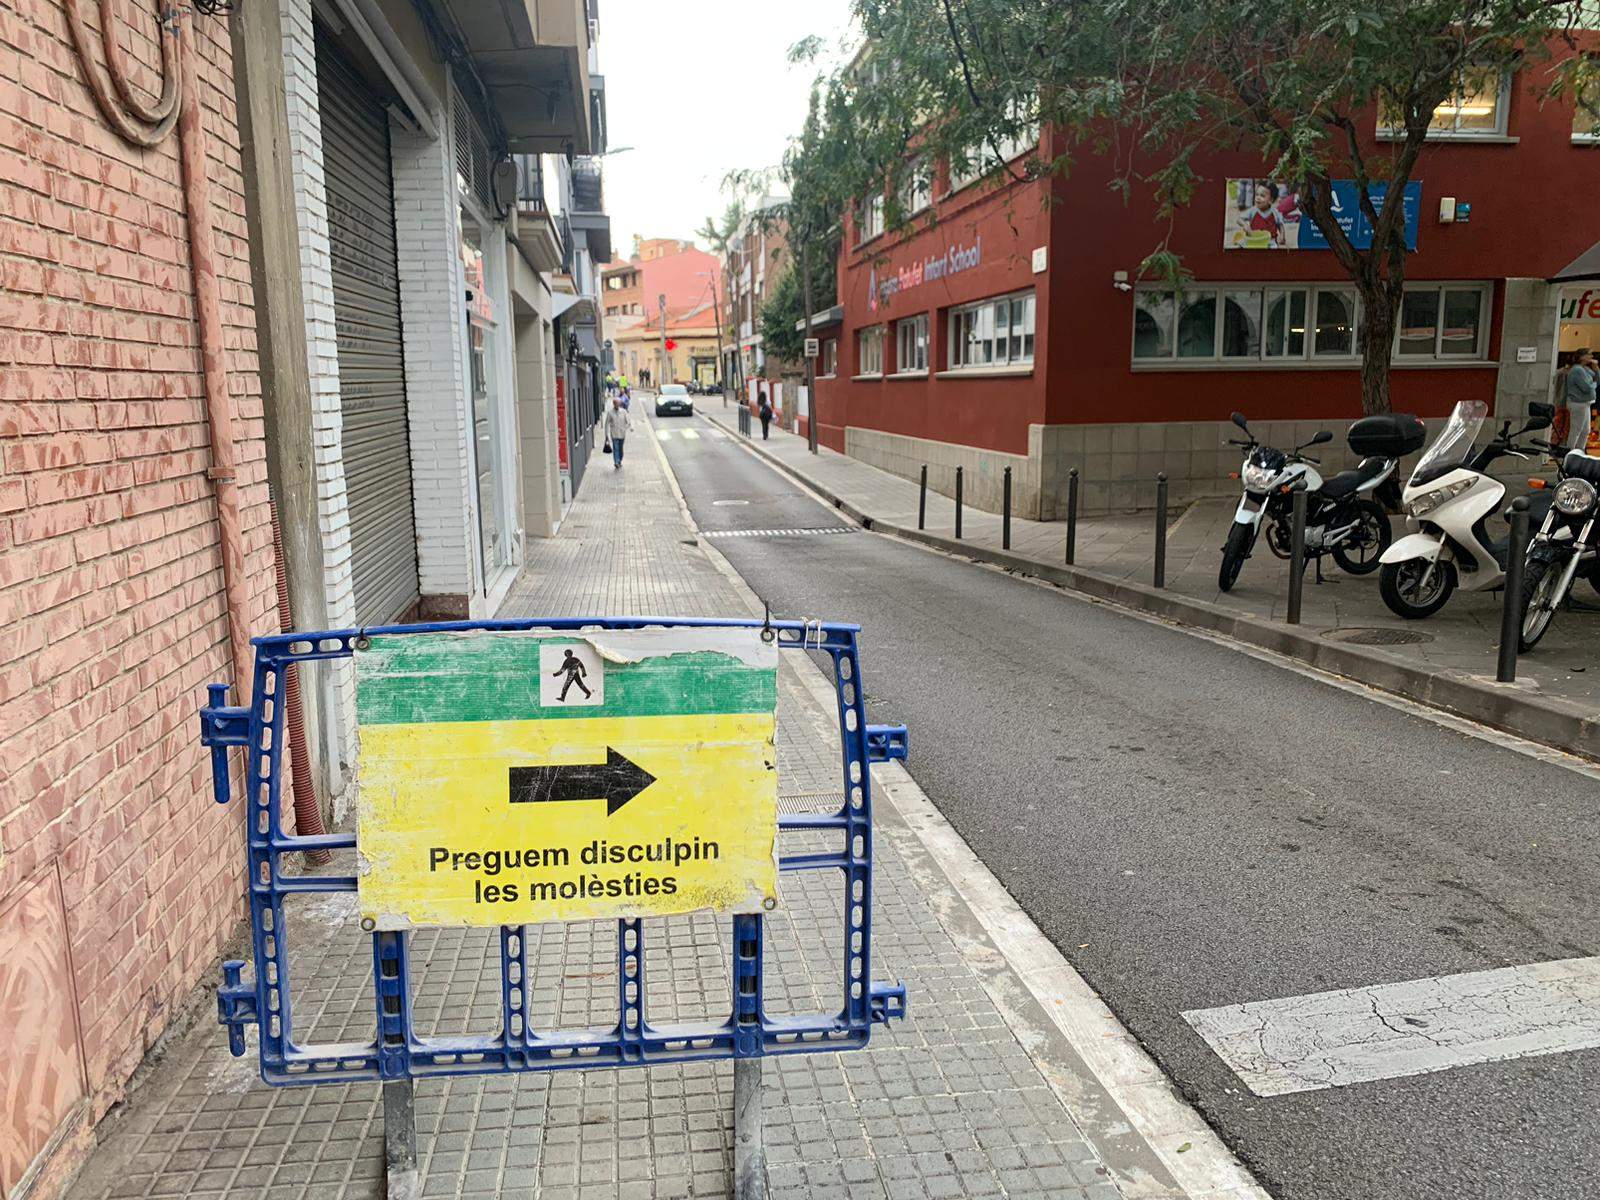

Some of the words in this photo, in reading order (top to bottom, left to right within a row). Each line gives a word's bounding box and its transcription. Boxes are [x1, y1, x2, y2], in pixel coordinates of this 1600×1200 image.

[925, 253, 948, 281] Infant
[950, 236, 980, 273] School
[429, 847, 569, 875] Preguem
[580, 836, 720, 867] disculpin
[475, 879, 519, 904] les
[530, 872, 678, 901] molèsties
